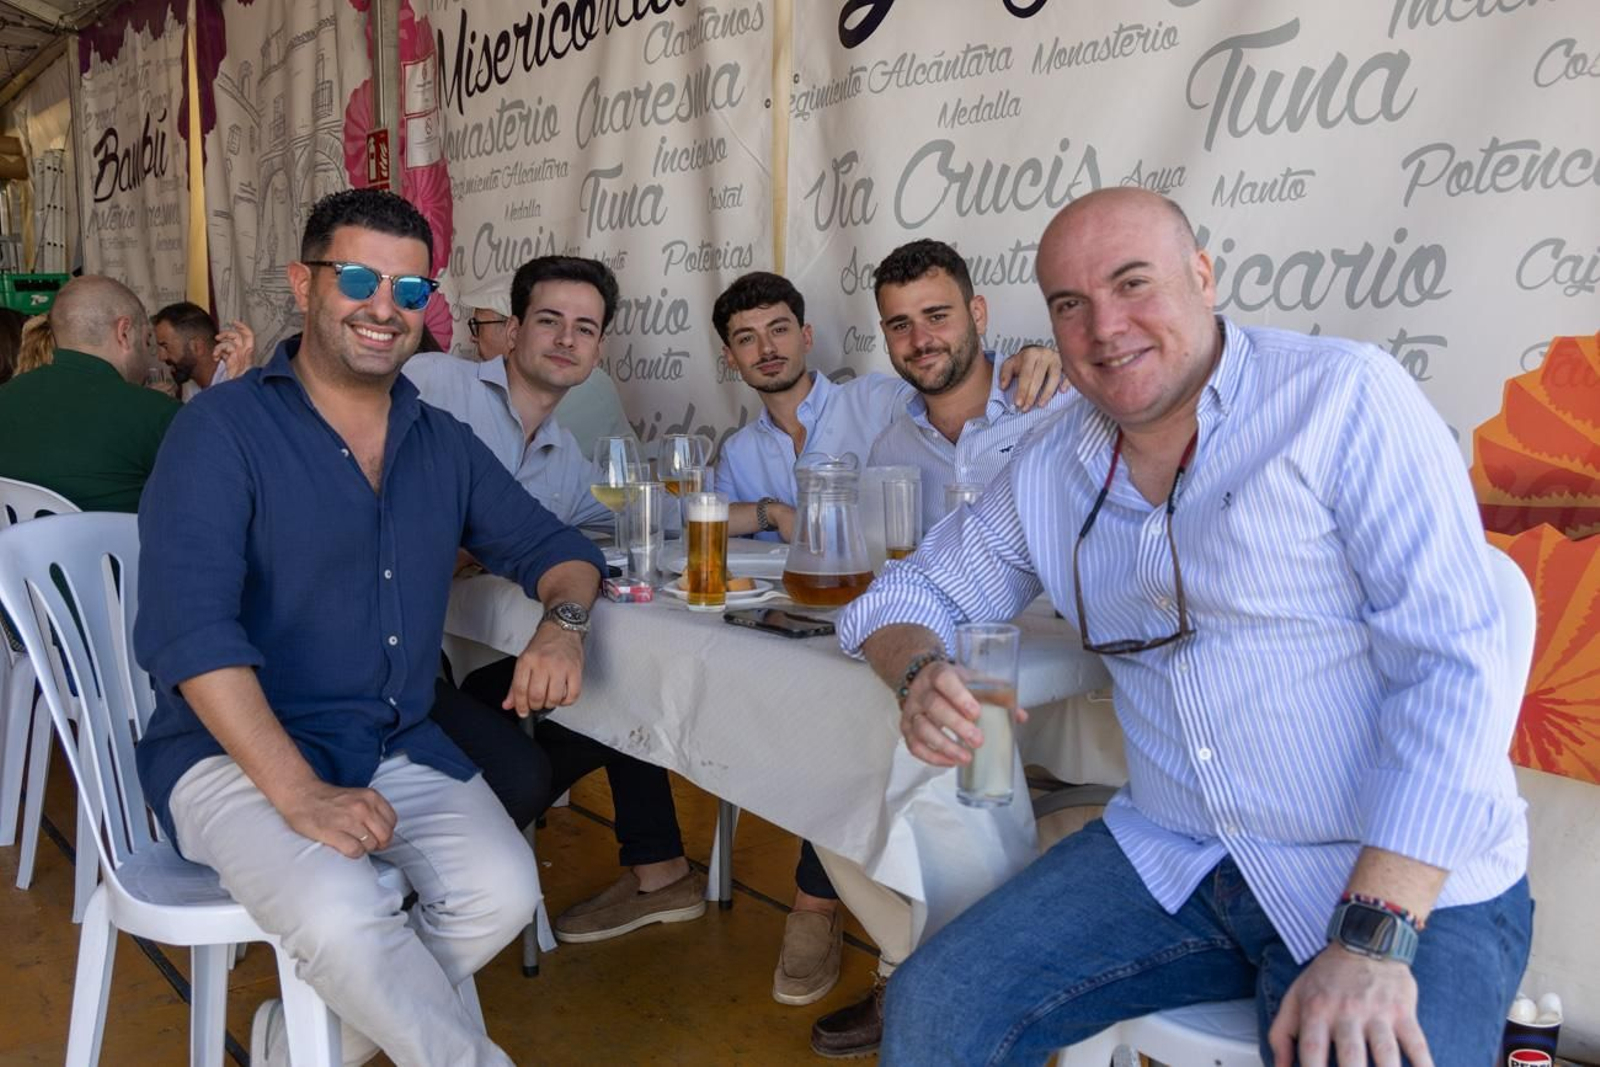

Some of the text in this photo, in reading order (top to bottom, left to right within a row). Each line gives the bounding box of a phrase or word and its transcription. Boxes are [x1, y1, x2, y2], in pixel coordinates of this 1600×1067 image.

[789, 42, 1014, 121] egimiento Alcántara
[1031, 20, 1179, 76] Monasterio
[1186, 17, 1418, 152] Tuna
[576, 61, 746, 150] Cuaresma
[937, 90, 1022, 129] Medalla
[579, 162, 668, 238] Tuna
[893, 137, 1103, 231] Crucis
[1211, 167, 1317, 208] Manto
[1196, 224, 1453, 312] icario
[605, 287, 692, 336] ario
[616, 343, 690, 383] Santo
